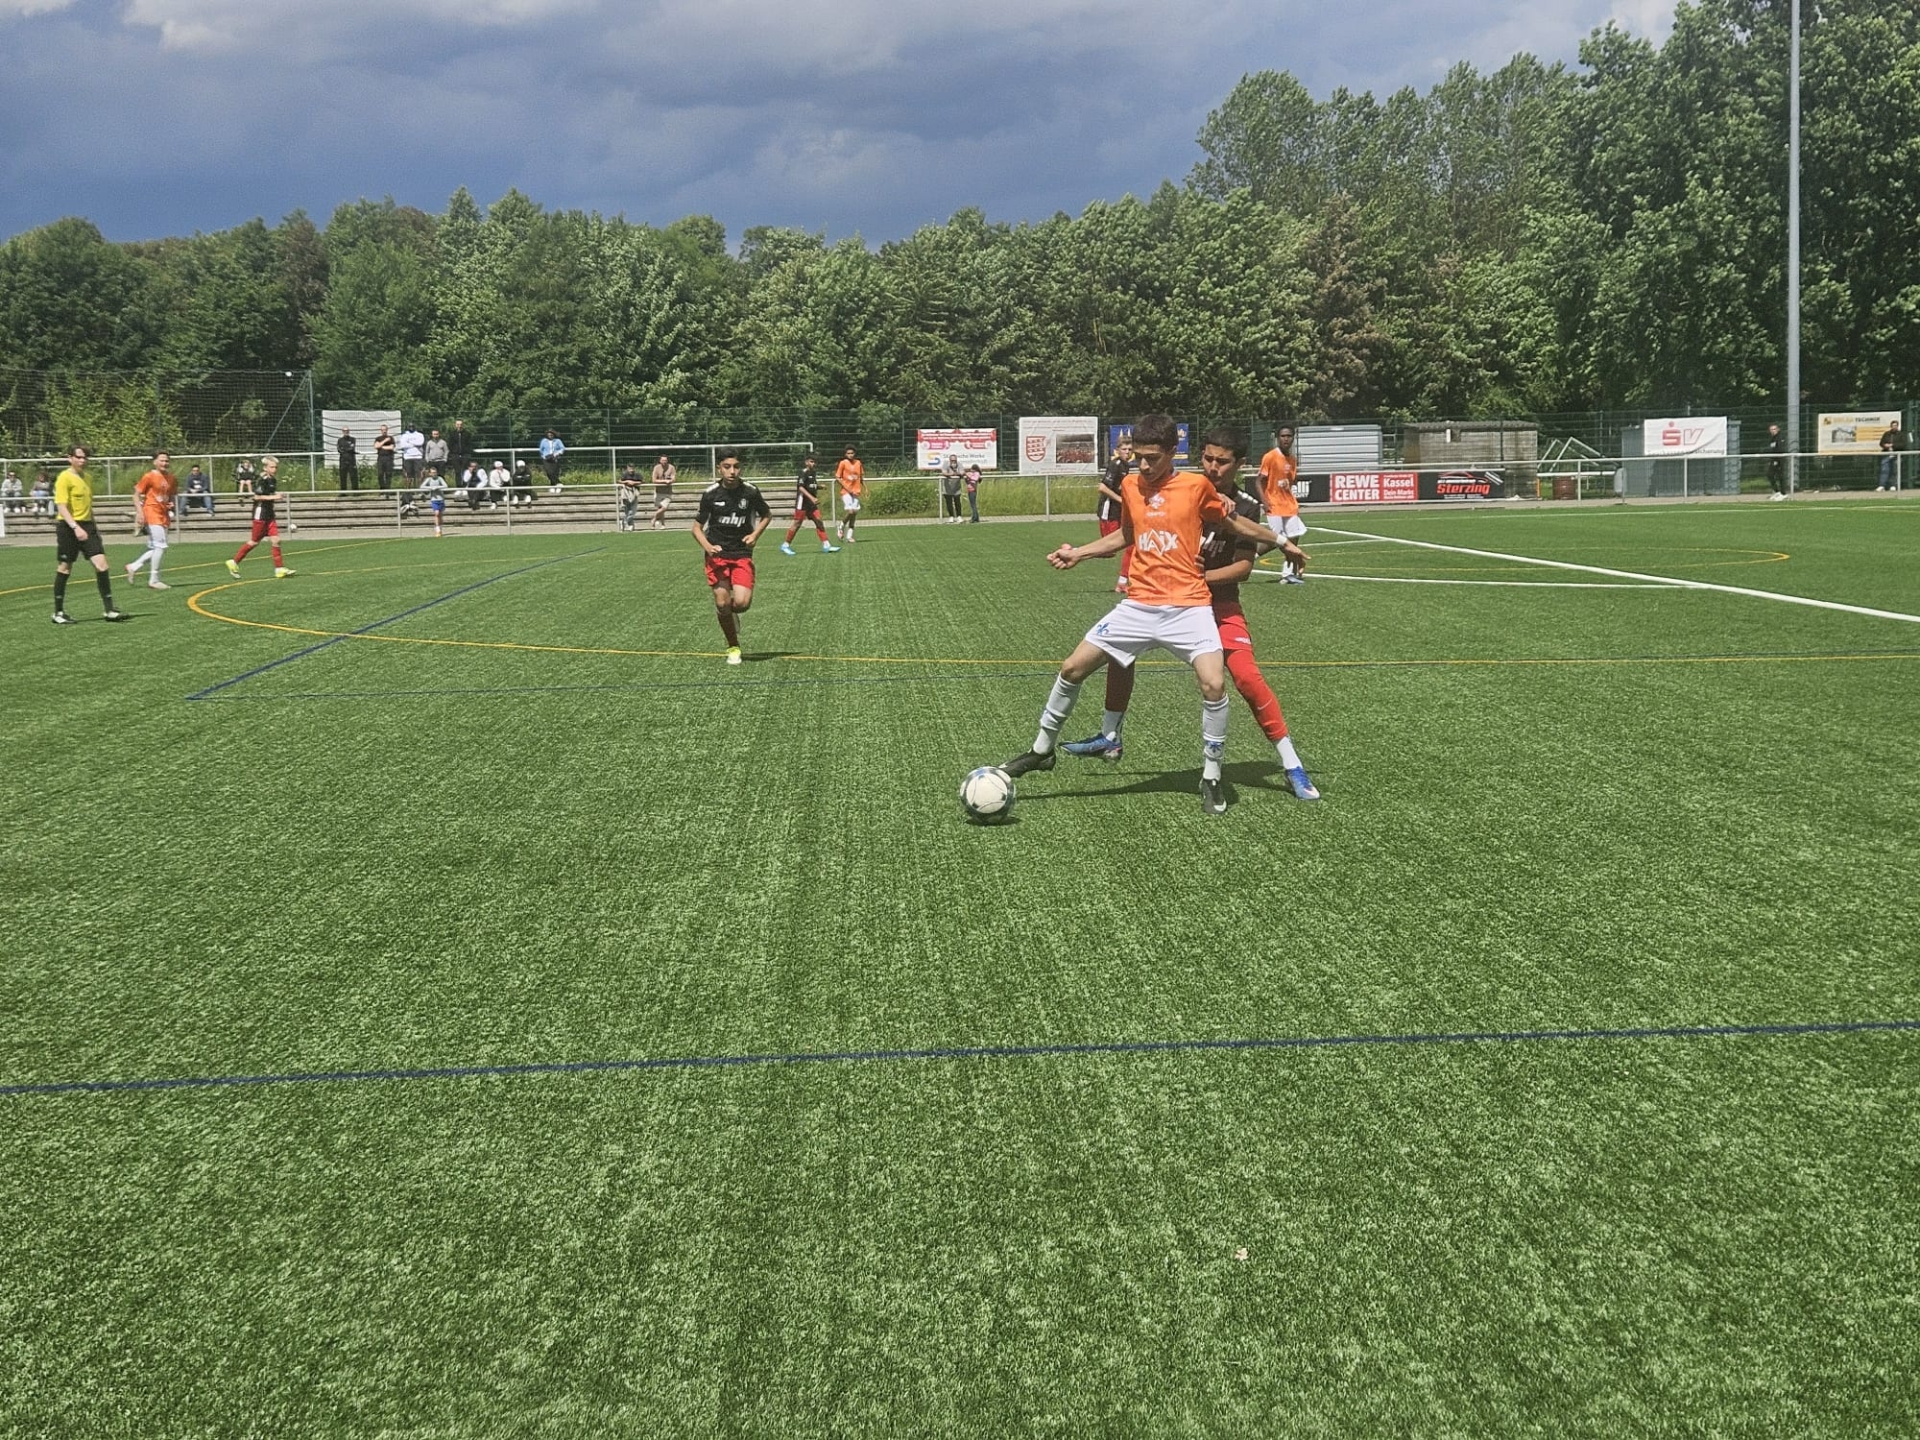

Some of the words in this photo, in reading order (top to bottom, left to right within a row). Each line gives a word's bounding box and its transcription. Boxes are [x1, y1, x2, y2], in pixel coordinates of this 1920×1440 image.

[1335, 475, 1380, 489] REWE
[1383, 476, 1414, 488] Kassel
[1335, 489, 1380, 501] CENTER
[1436, 483, 1491, 495] Sterzing
[718, 512, 746, 527] mhp
